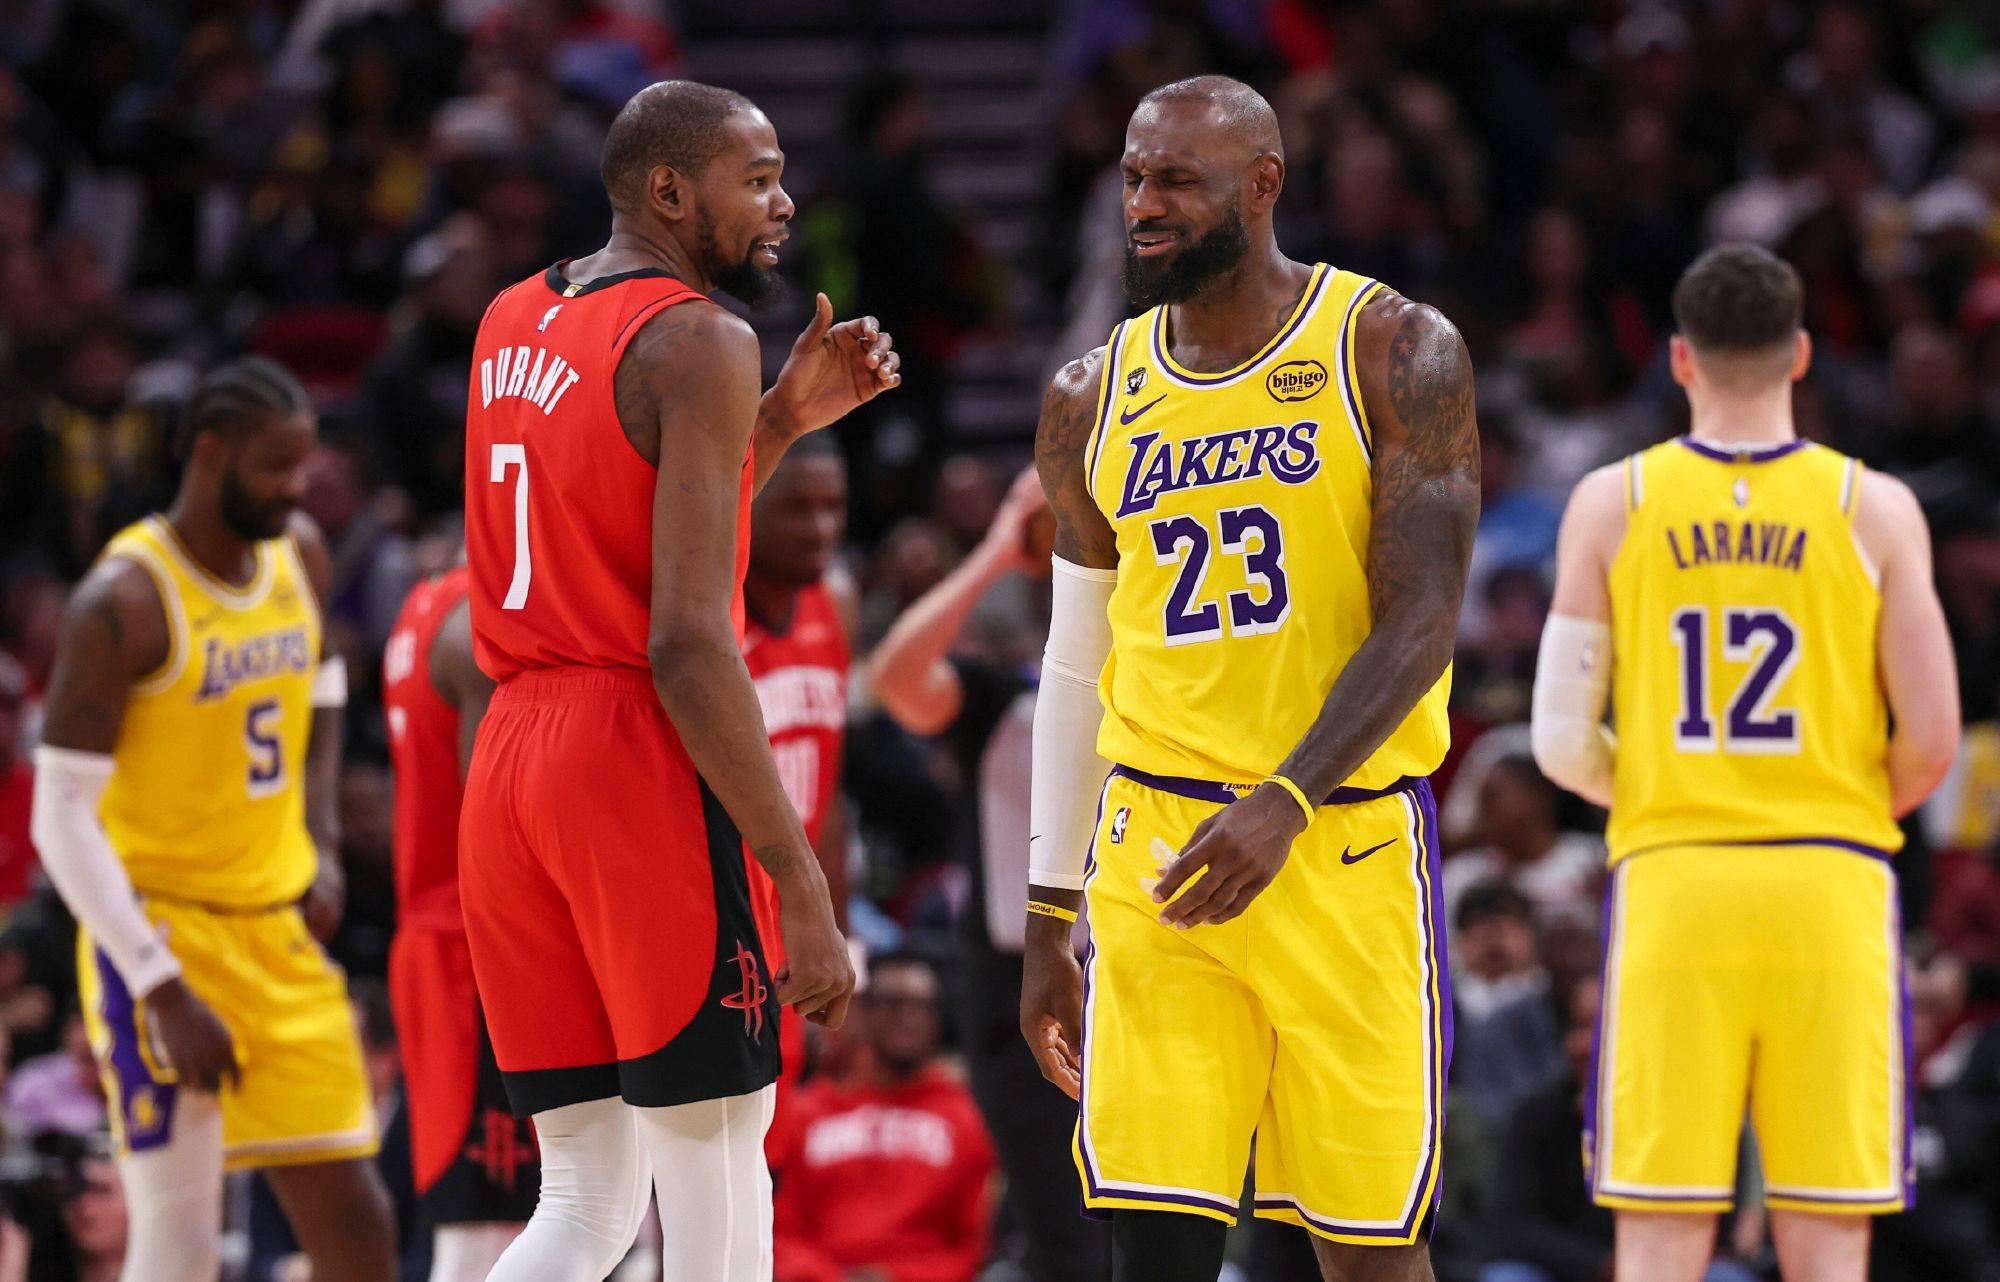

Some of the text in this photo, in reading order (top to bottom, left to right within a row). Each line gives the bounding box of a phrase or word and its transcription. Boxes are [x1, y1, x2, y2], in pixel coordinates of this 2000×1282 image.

[480, 345, 581, 416] DURANT
[1272, 371, 1324, 388] bibigo
[1281, 385, 1304, 394] 비비고
[1115, 420, 1323, 521] LAKERS
[490, 443, 532, 610] 7
[1146, 503, 1292, 647] 23
[1666, 521, 1807, 571] LARAVIA
[1671, 605, 1802, 753] 12
[245, 698, 287, 797] 5
